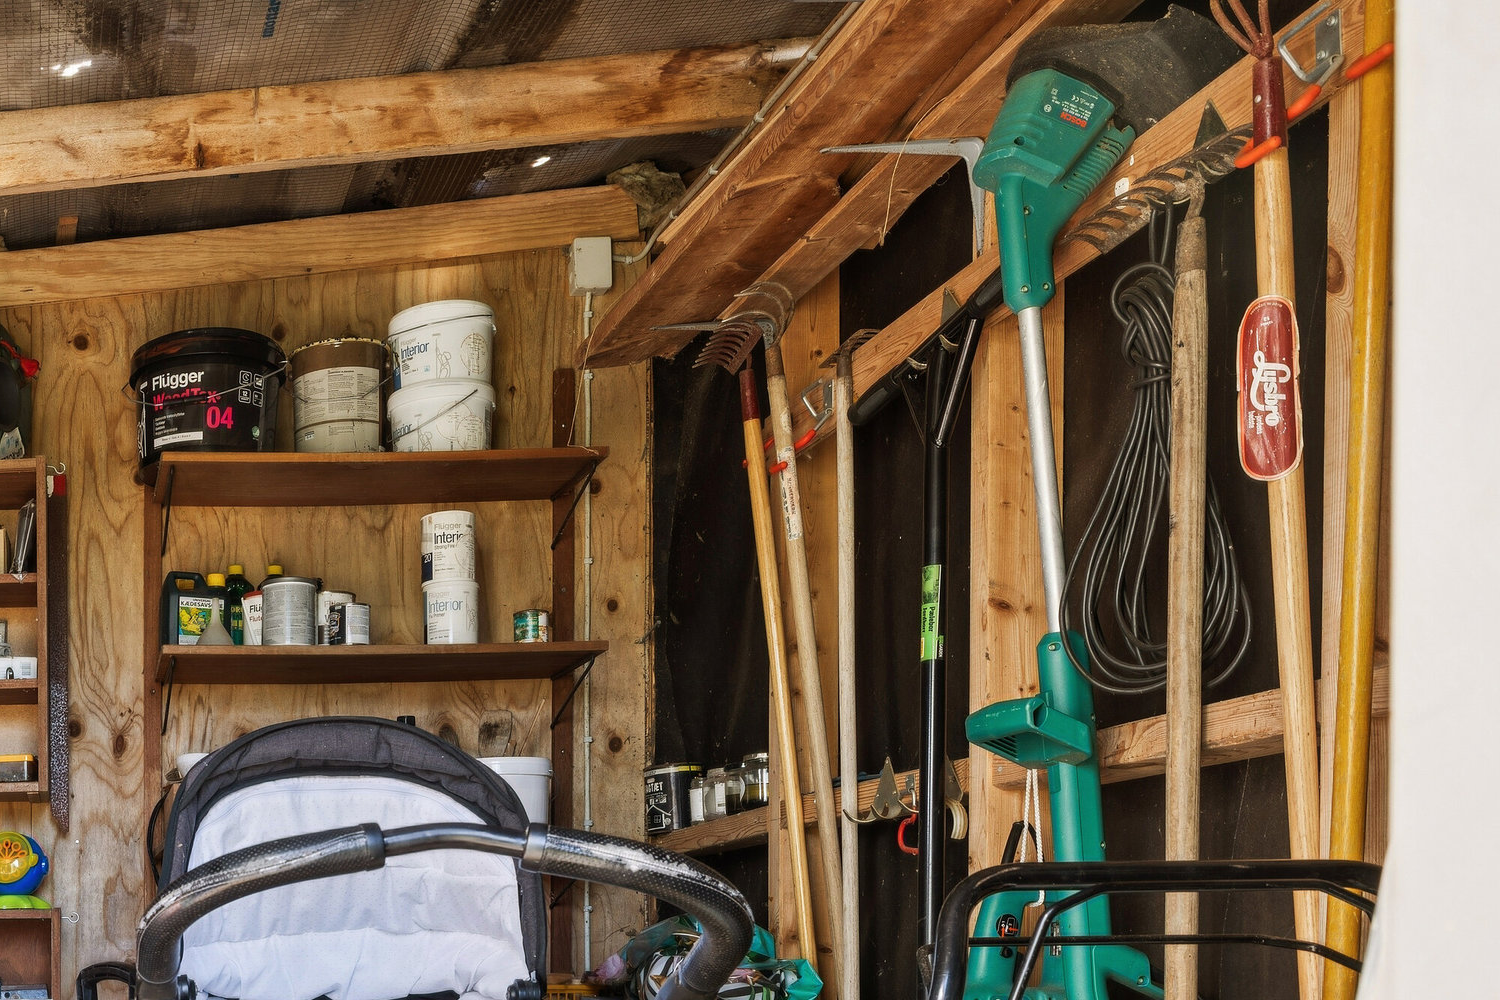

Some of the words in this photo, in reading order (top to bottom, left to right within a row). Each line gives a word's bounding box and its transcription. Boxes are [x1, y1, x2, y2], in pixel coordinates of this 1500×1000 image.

[1060, 112, 1087, 128] BOSCH
[401, 342, 430, 360] Interior
[152, 371, 205, 391] Flügger
[206, 405, 234, 429] 04
[423, 553, 432, 563] 20
[428, 600, 463, 614] Interior
